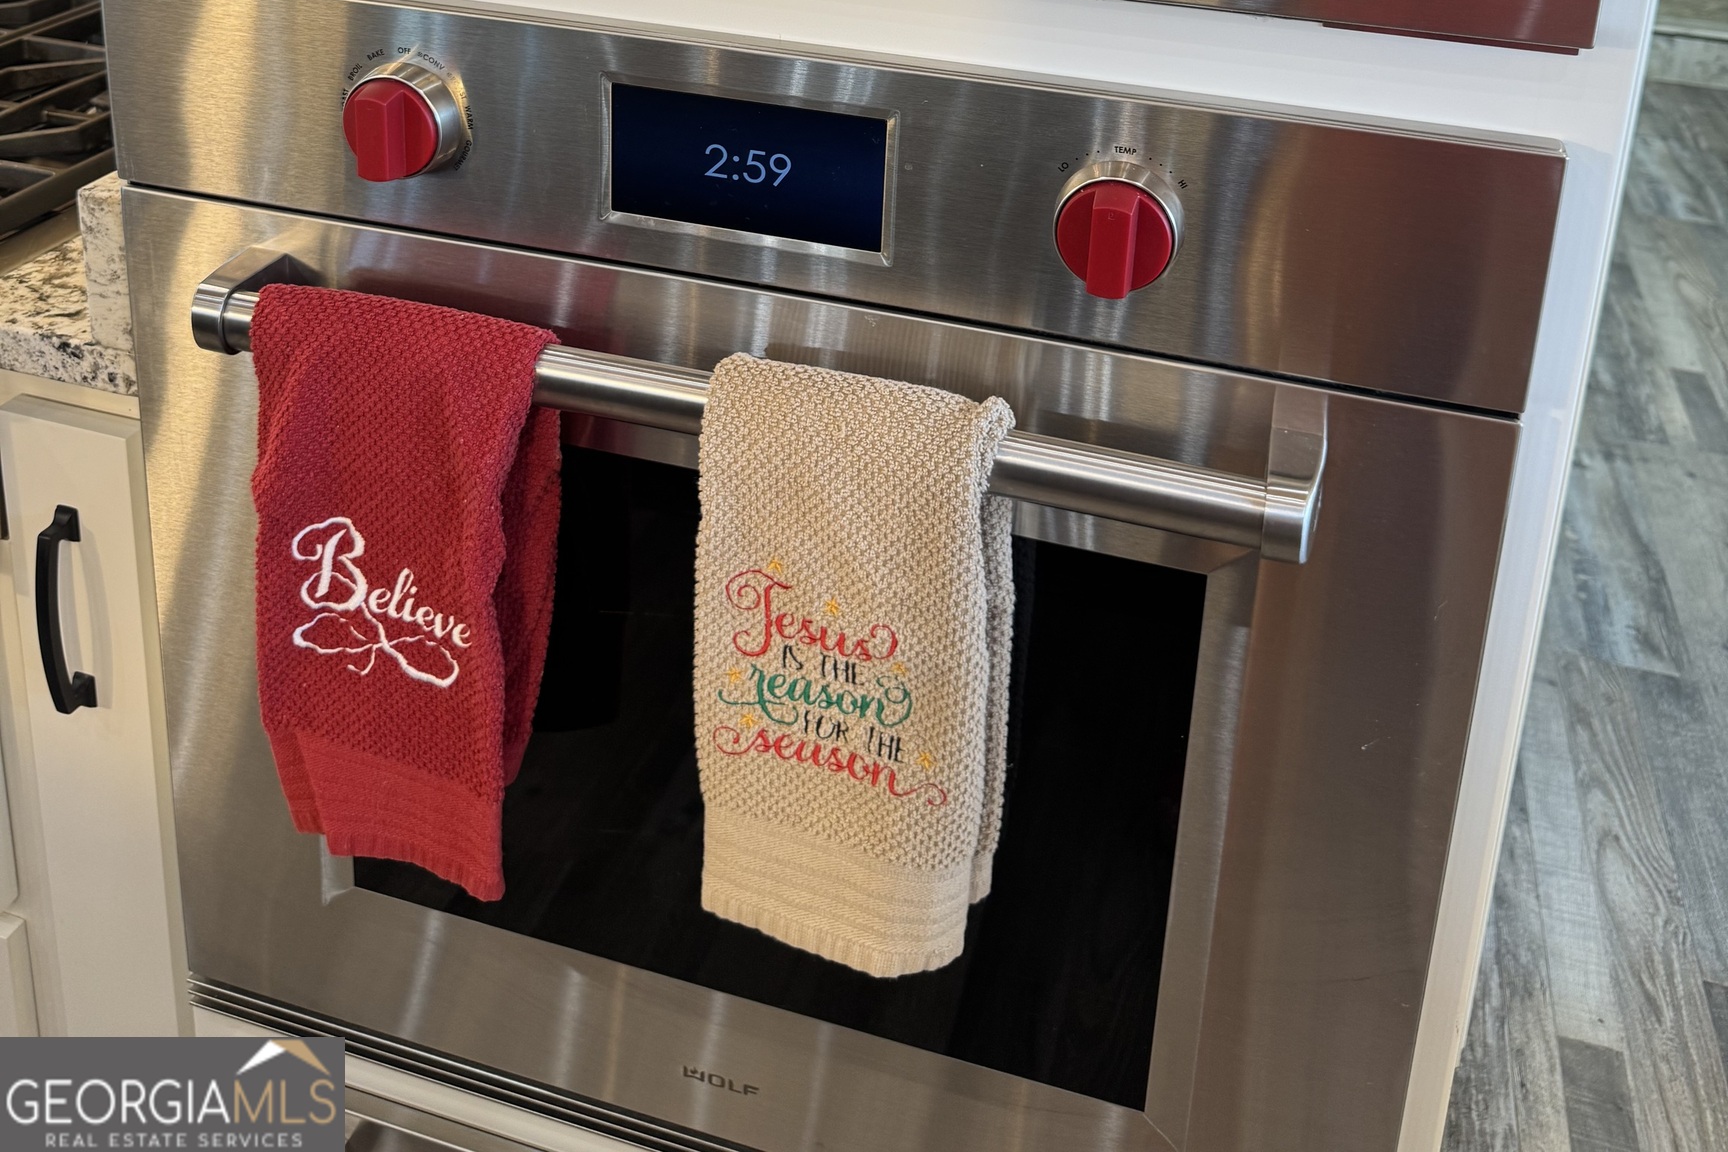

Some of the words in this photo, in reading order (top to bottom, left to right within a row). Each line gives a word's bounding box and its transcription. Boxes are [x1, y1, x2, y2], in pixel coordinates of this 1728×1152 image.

[366, 48, 385, 61] BAKE
[423, 53, 445, 70] CONV
[347, 63, 363, 81] BROIL
[465, 105, 474, 130] WARM
[454, 139, 473, 171] GOURMET
[704, 144, 792, 187] 2:59
[1114, 146, 1137, 155] TEMP
[1058, 161, 1069, 172] LO
[1178, 179, 1188, 189] HI
[292, 516, 473, 649] Believe
[725, 570, 898, 662] Jesus
[782, 645, 803, 671] IS
[820, 652, 865, 686] THE
[718, 664, 913, 728] reason
[804, 710, 849, 743] FOR
[867, 726, 904, 764] THE
[713, 726, 947, 807] season
[683, 1065, 760, 1095] WOLF
